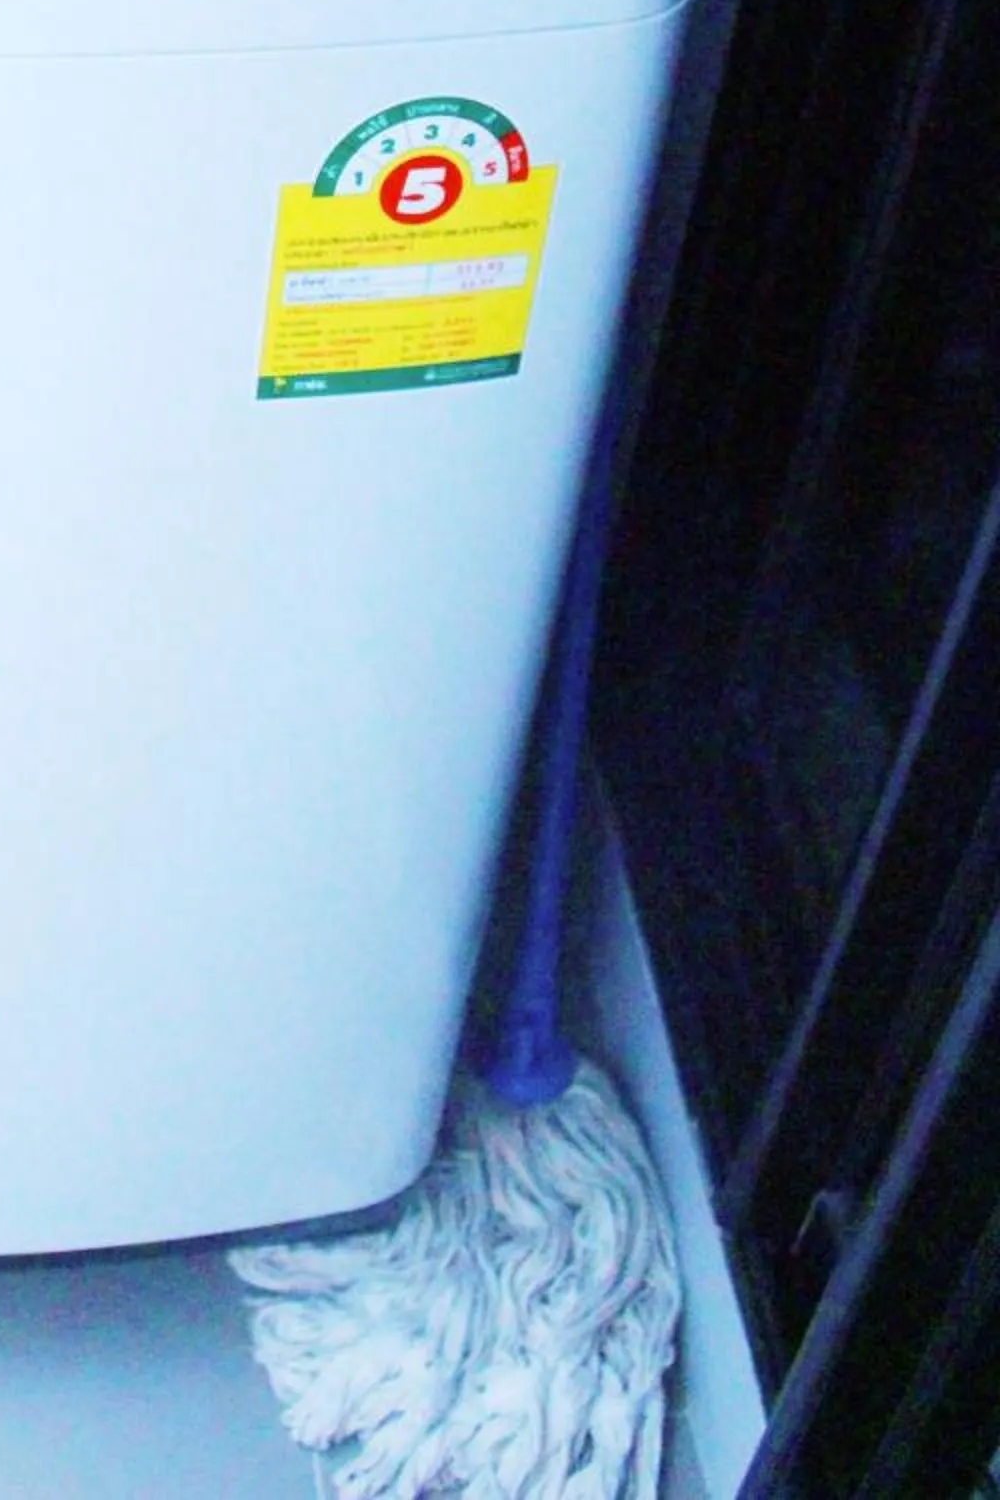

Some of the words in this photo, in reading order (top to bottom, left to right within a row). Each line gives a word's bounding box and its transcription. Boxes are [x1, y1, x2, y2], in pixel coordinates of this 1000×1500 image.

[423, 124, 440, 140] 3
[461, 132, 477, 148] 4
[380, 138, 397, 155] 2
[484, 161, 498, 177] 5
[354, 171, 364, 186] 1
[396, 165, 448, 216] 5
